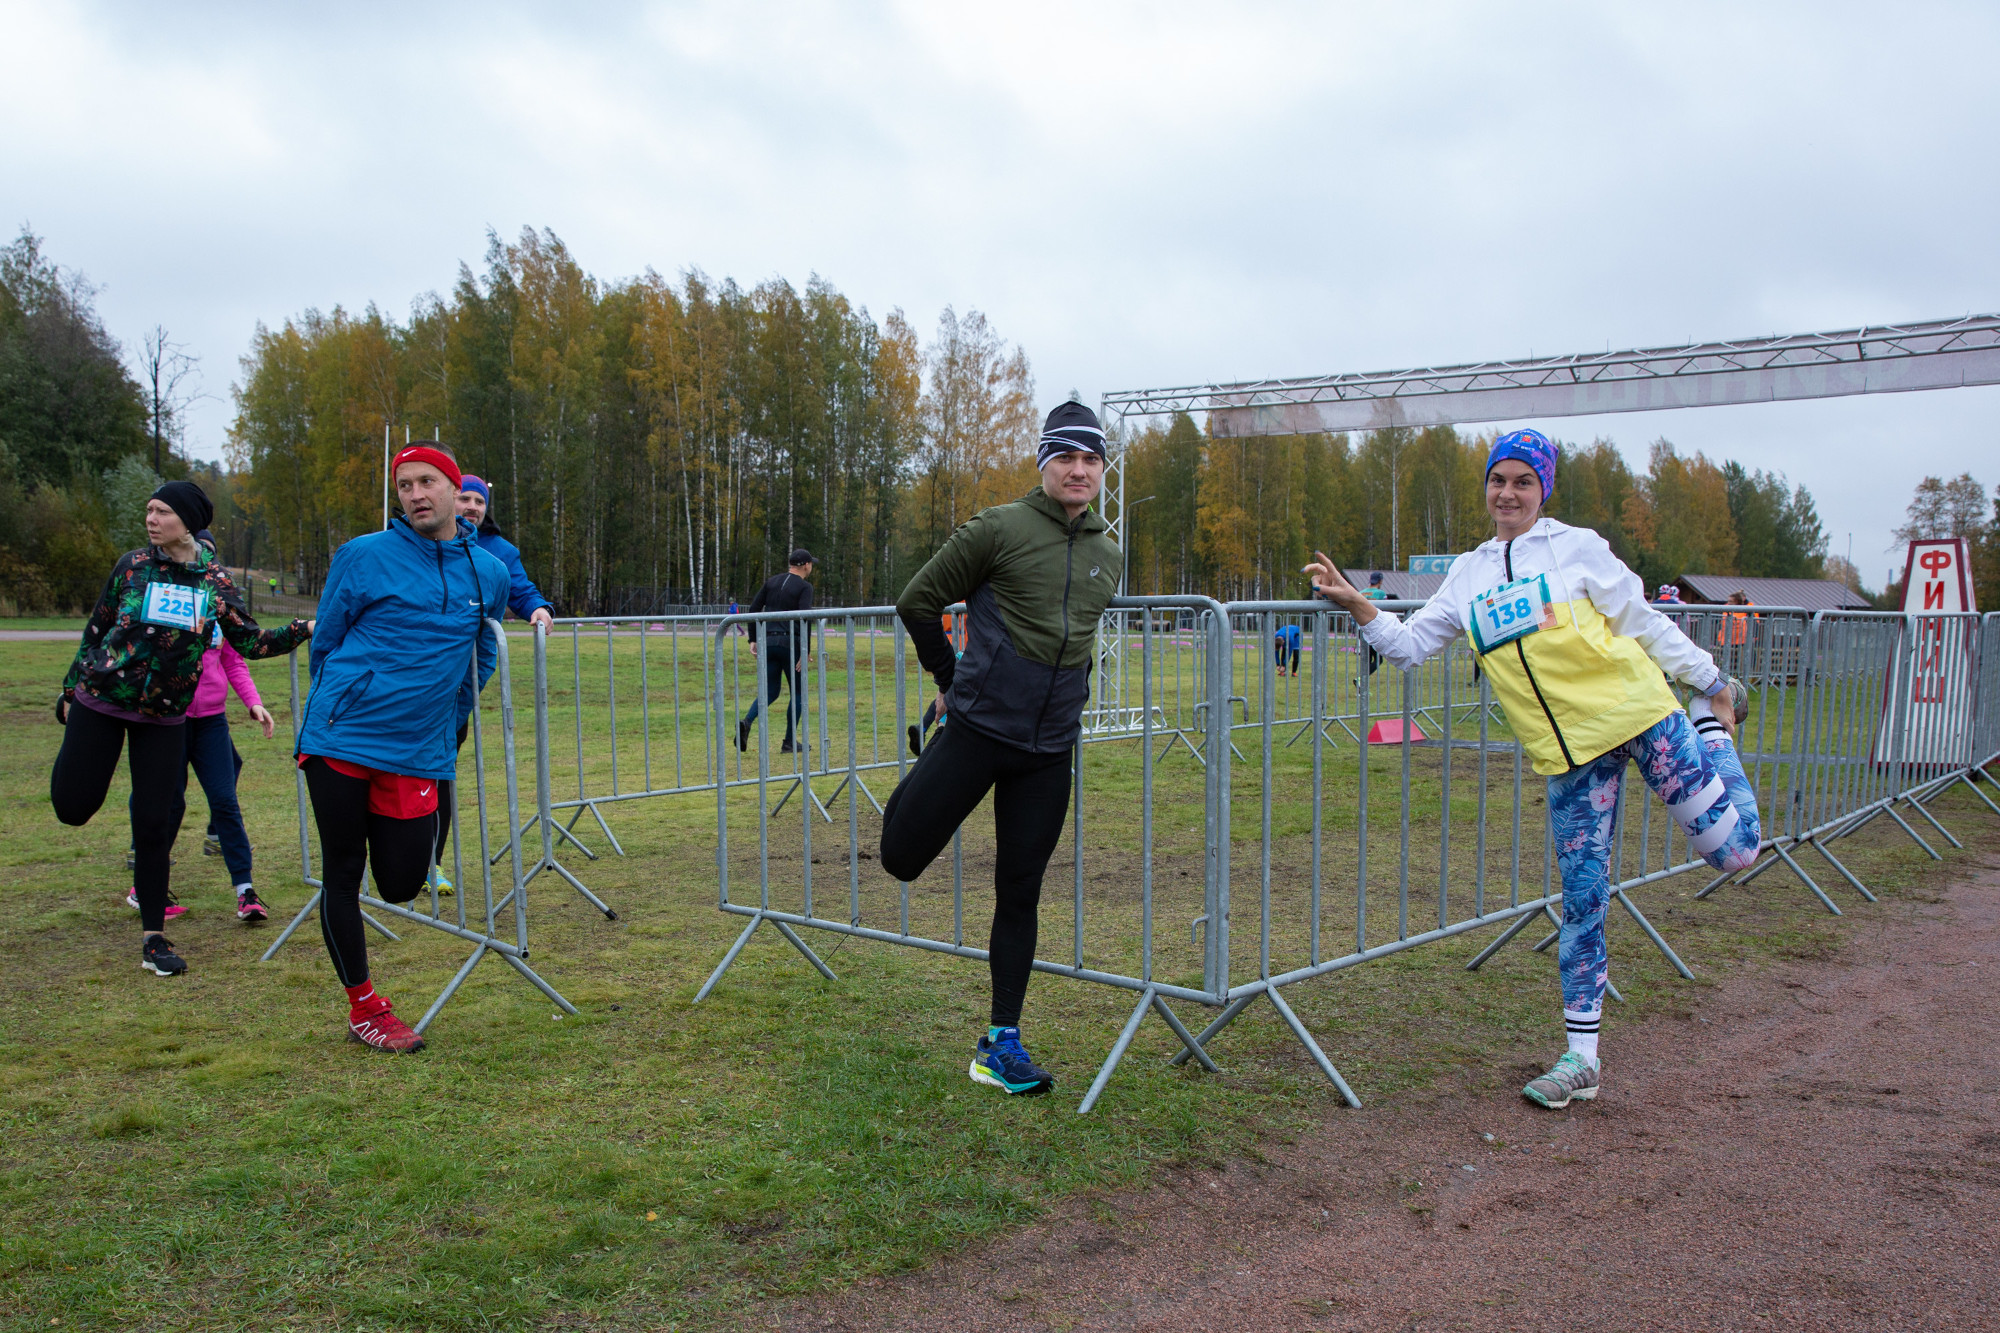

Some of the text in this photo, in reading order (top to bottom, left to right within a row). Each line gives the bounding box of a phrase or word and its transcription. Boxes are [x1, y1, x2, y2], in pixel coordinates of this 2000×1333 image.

[1431, 559, 1452, 572] СТ
[158, 598, 194, 618] 225
[1487, 597, 1532, 630] 138
